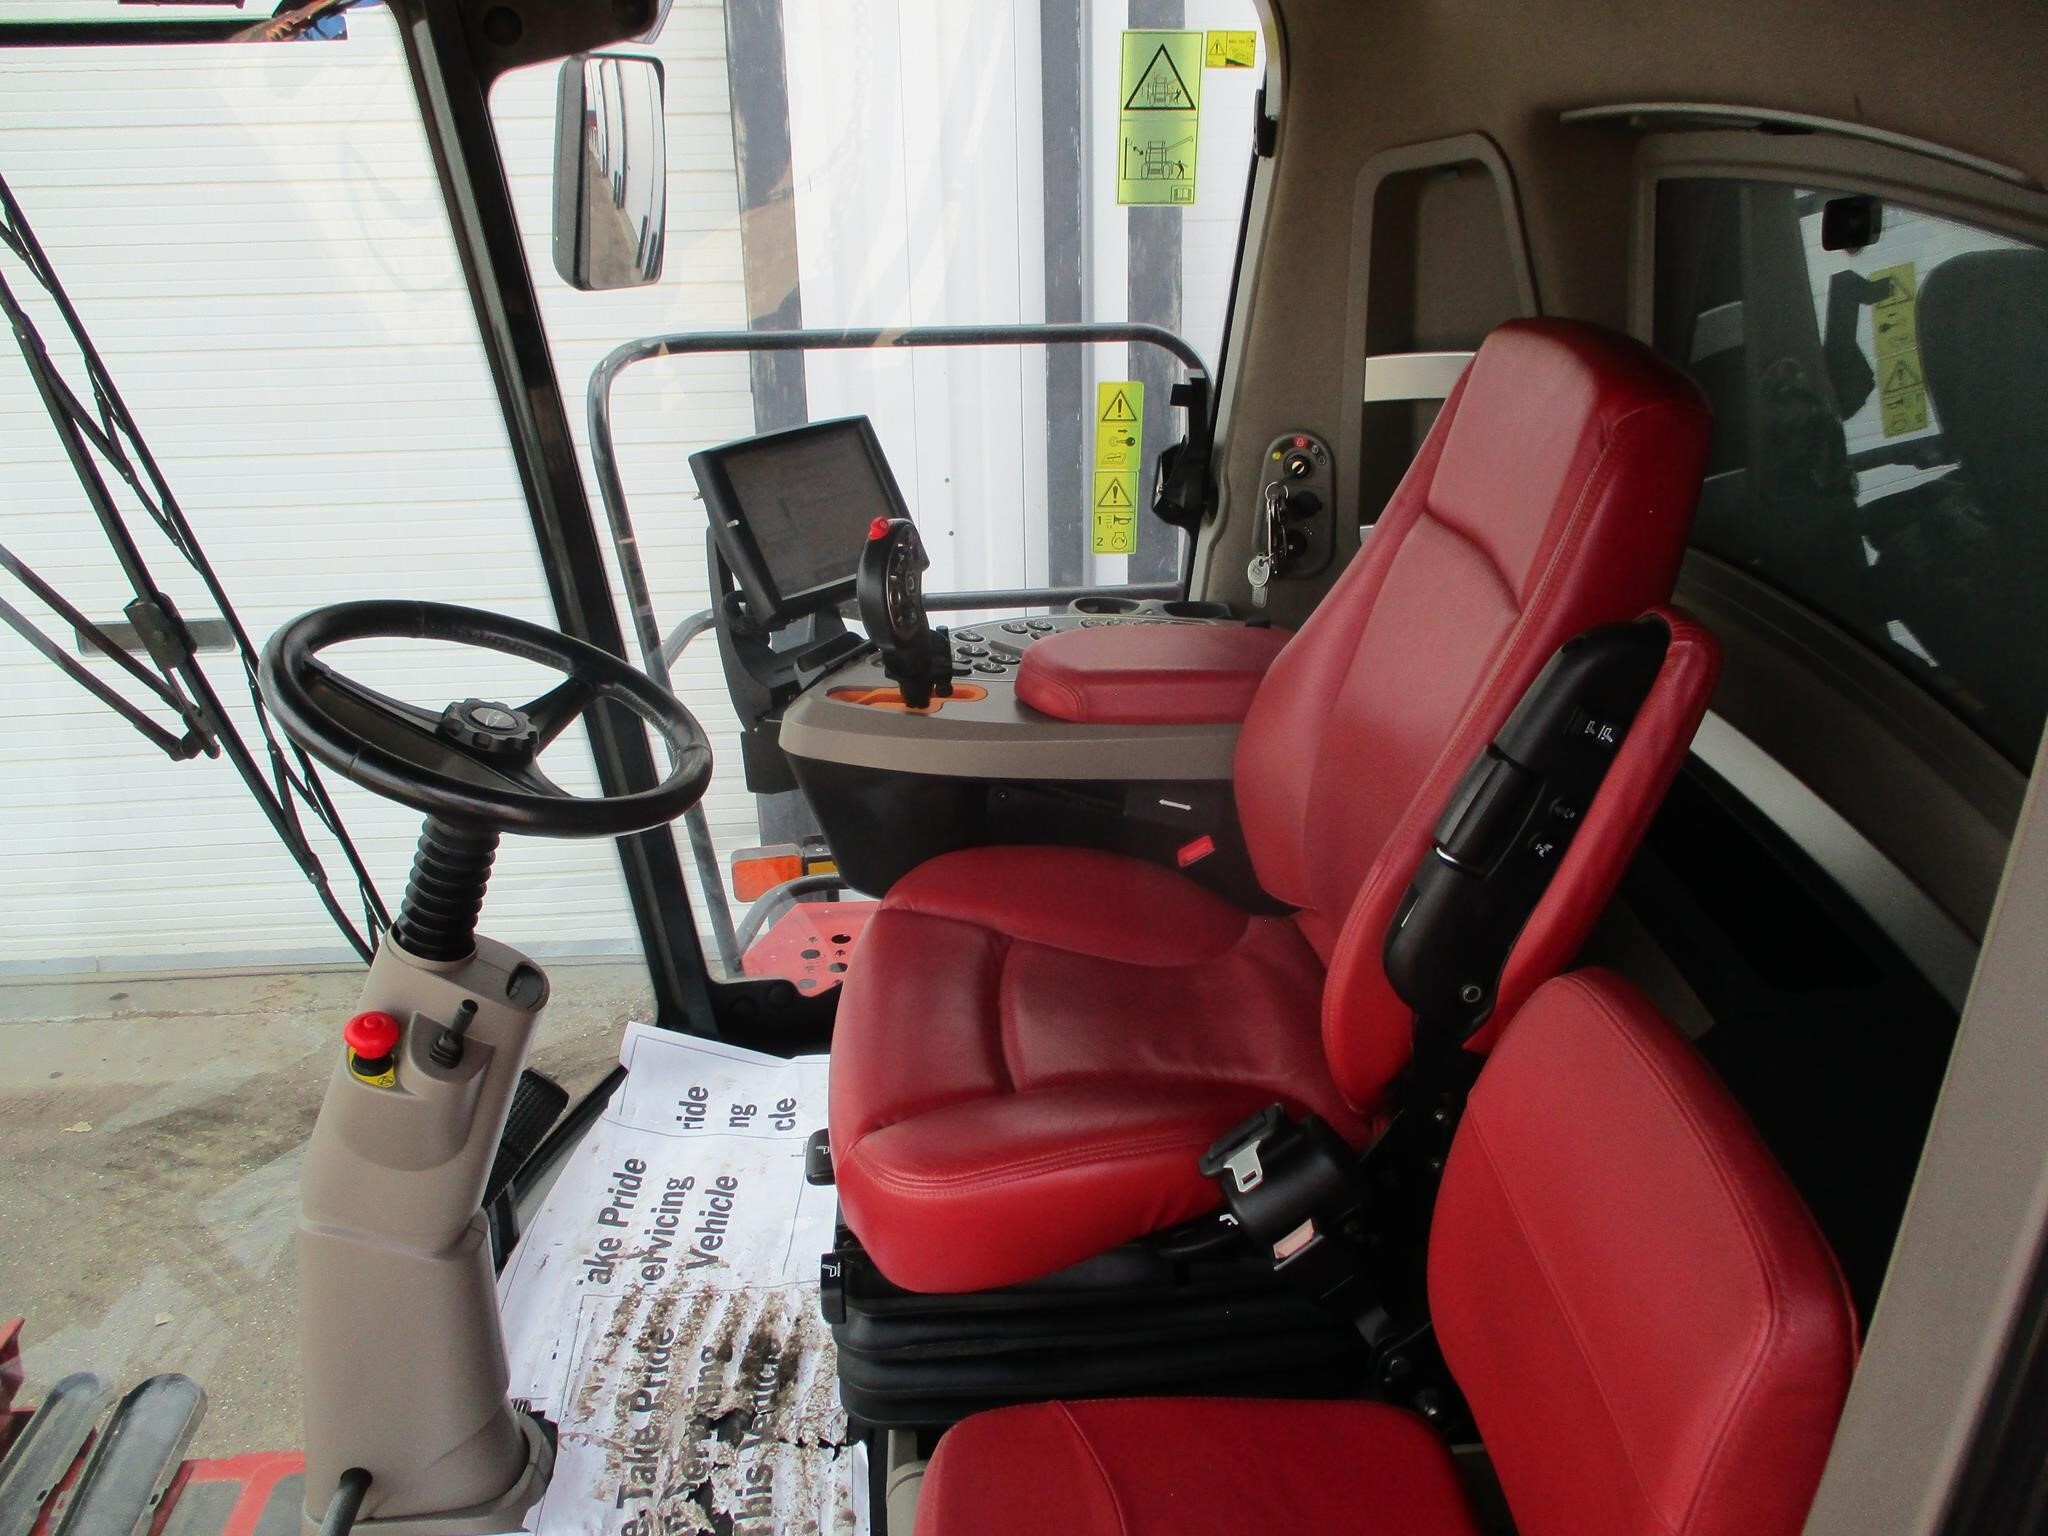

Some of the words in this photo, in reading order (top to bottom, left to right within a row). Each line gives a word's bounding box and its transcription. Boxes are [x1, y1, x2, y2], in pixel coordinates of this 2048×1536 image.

[1096, 536, 1103, 546] 2
[768, 1097, 797, 1131] cle
[597, 1157, 648, 1228] Pride
[640, 1175, 695, 1286] ervicing
[685, 1175, 739, 1270] Vehicle
[582, 1236, 623, 1285] ake
[627, 1328, 675, 1412] Pride
[616, 1425, 662, 1509] Take
